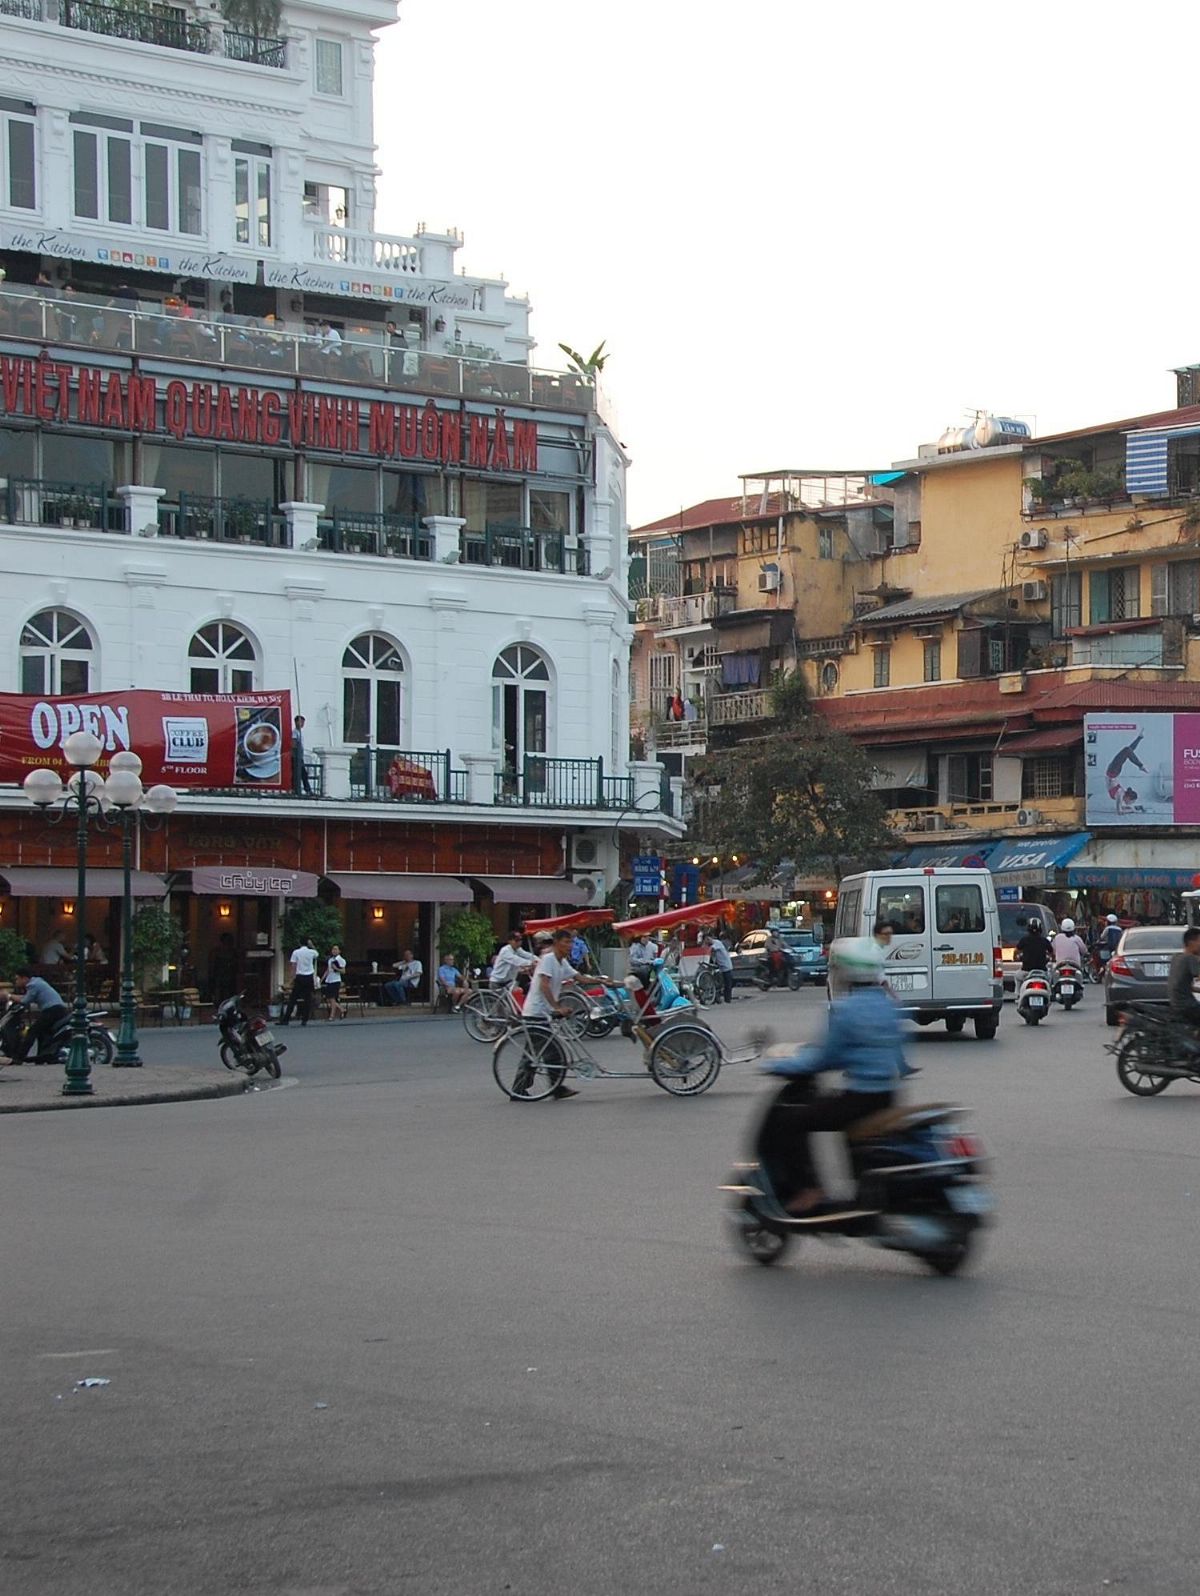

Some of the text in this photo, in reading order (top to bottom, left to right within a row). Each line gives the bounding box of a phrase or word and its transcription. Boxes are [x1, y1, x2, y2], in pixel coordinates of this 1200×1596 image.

[12, 232, 86, 257] the Kitchen
[179, 256, 248, 278] the Kitchen
[268, 268, 334, 290] the Kitchen
[407, 285, 469, 306] the Kitchen
[166, 379, 281, 446] QUANG
[287, 391, 360, 451] VINH
[369, 398, 461, 465] MUÔN
[31, 701, 131, 751] OPEN
[172, 737, 204, 747] CLUB
[21, 756, 50, 765] FROM
[998, 852, 1047, 869] VISA
